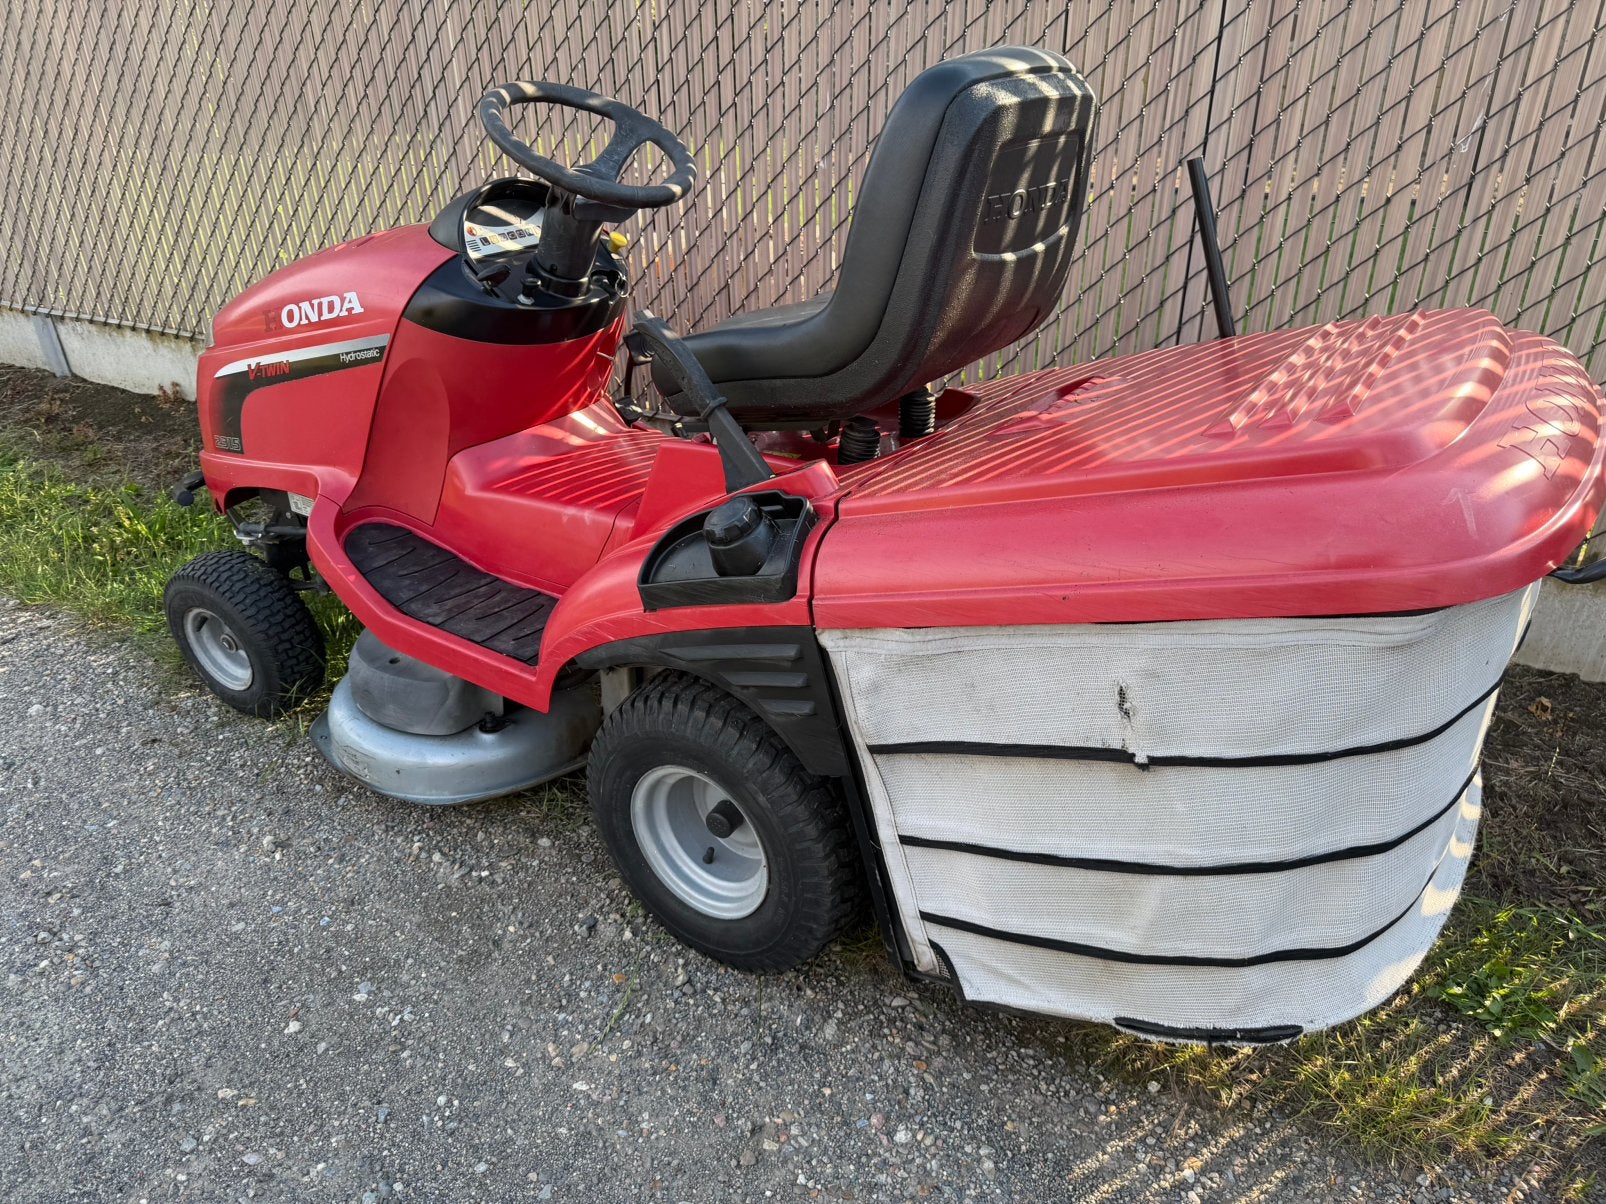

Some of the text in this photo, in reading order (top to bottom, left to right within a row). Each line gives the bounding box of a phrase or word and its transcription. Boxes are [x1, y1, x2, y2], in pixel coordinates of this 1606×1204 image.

[262, 291, 365, 333] HONDA
[247, 347, 380, 381] V-TWIN Hydrostatic
